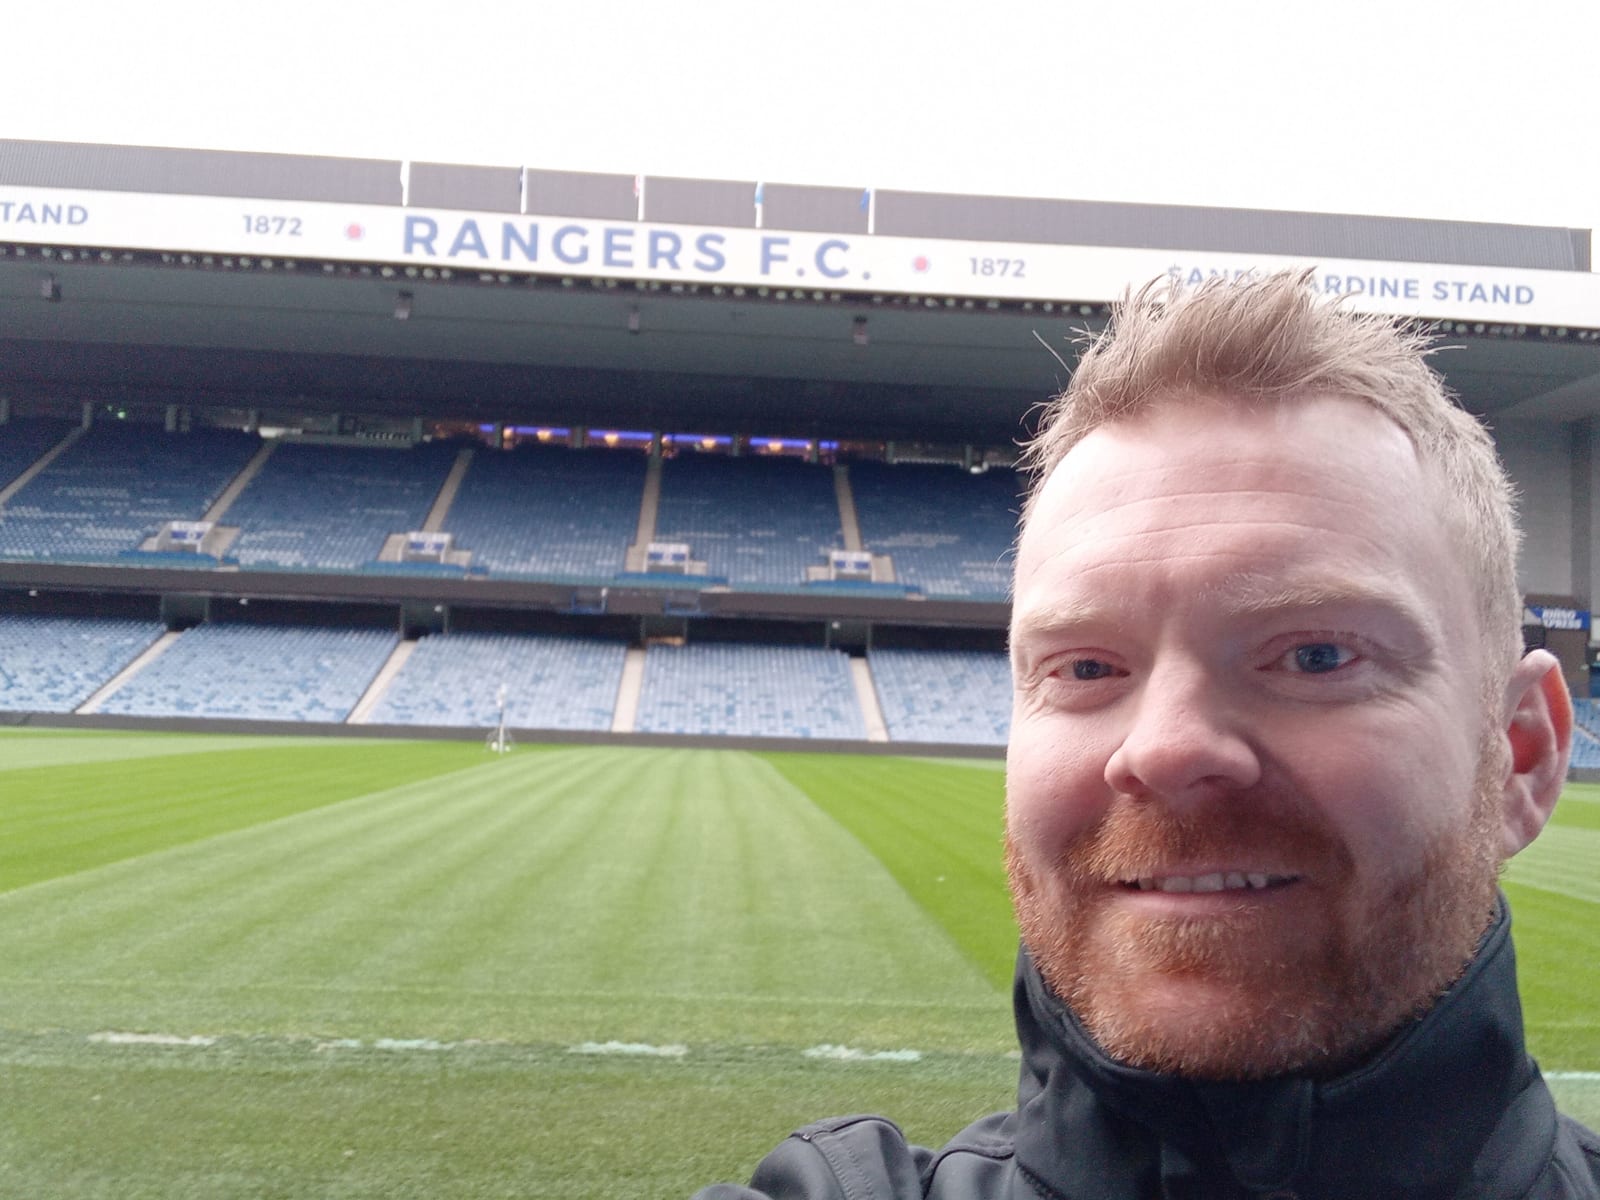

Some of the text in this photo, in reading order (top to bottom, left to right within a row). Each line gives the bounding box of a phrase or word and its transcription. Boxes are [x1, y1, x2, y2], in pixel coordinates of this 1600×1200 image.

[242, 214, 303, 236] 1872
[403, 215, 871, 281] RANGERS F.C.
[969, 257, 1026, 278] 1872
[1305, 271, 1420, 299] ARDINE
[1432, 280, 1535, 305] STAND
